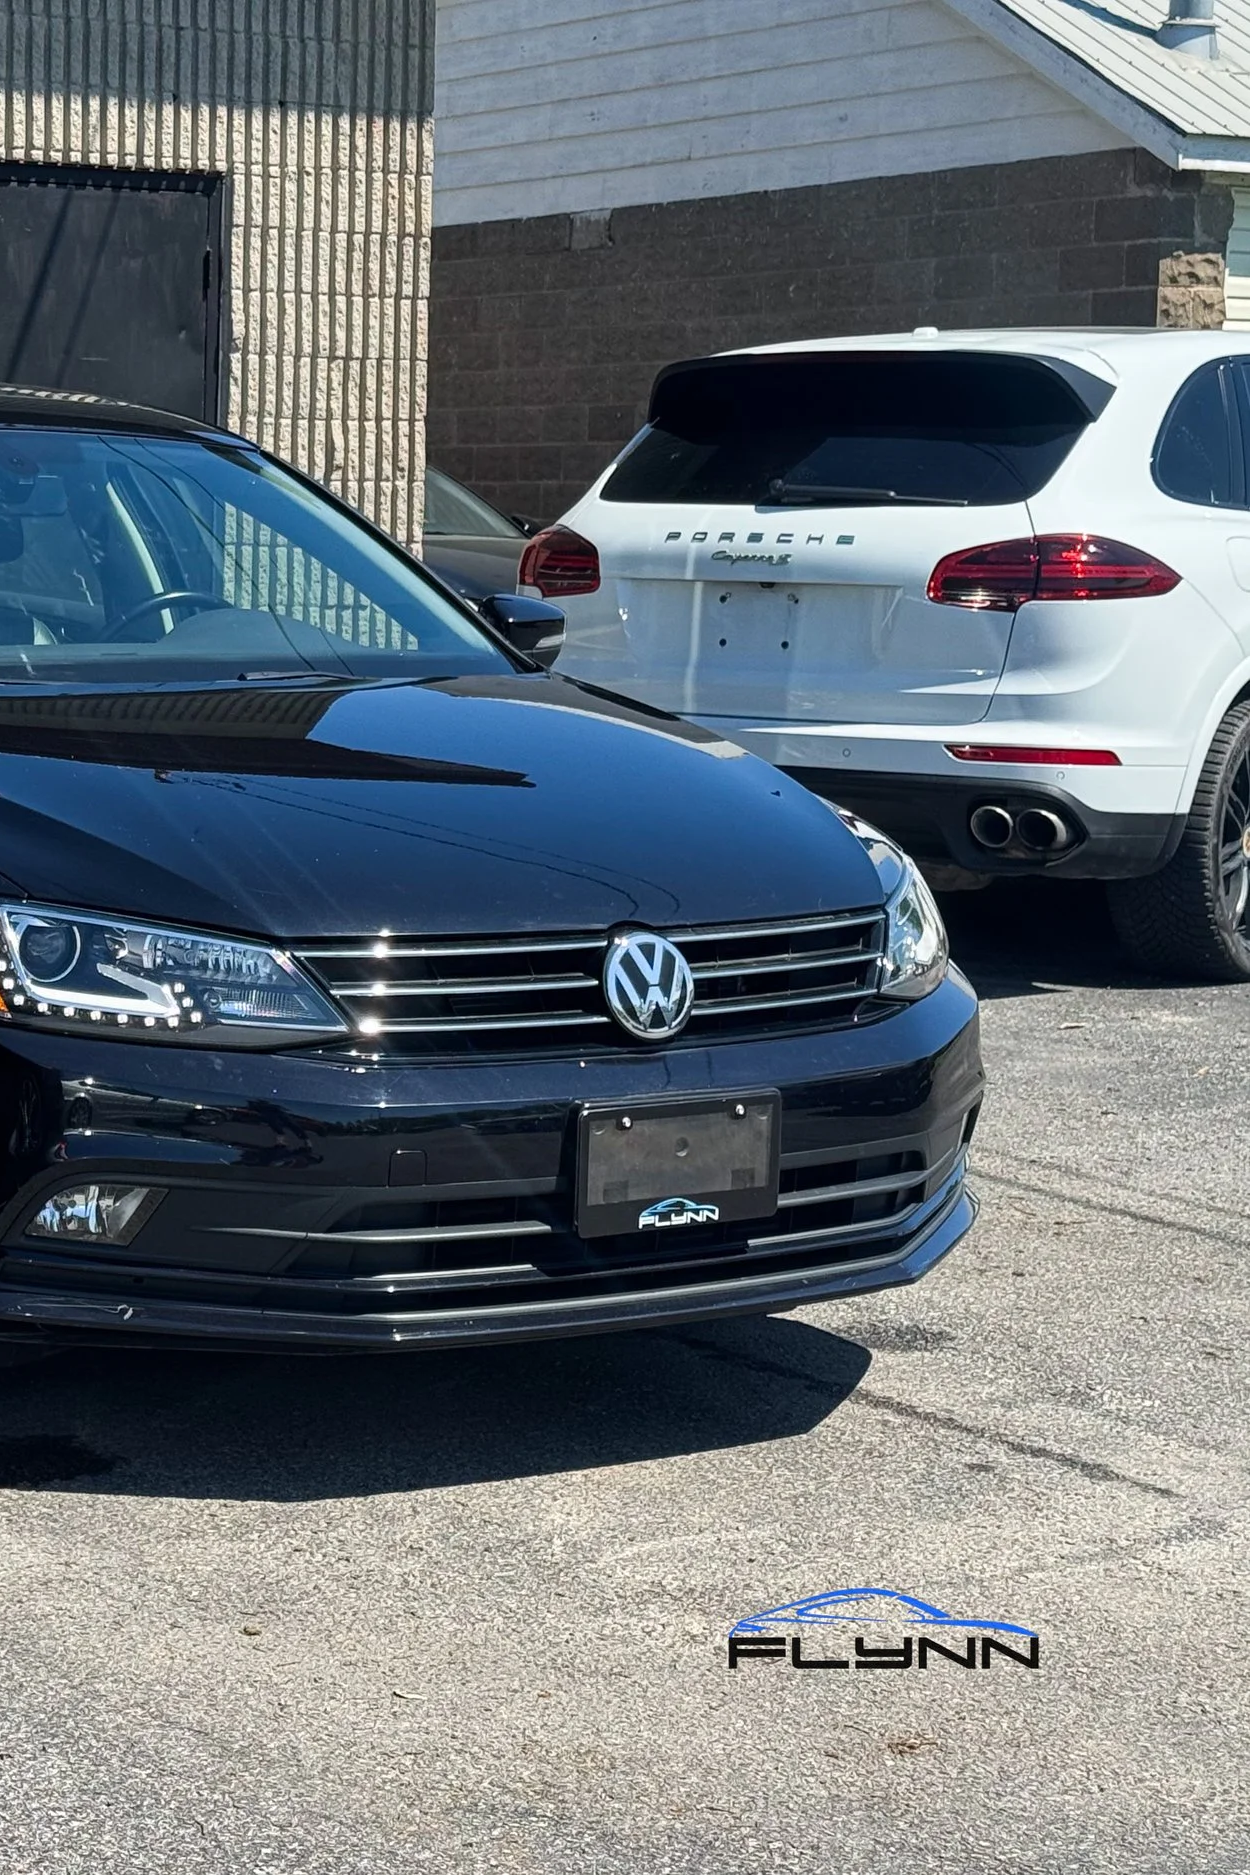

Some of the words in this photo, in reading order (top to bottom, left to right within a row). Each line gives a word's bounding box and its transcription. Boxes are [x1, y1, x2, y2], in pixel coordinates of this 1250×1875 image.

[664, 531, 856, 545] PORSCHE
[711, 550, 773, 566] Cayenne
[606, 934, 692, 1037] VW
[638, 1208, 719, 1229] FLYNN
